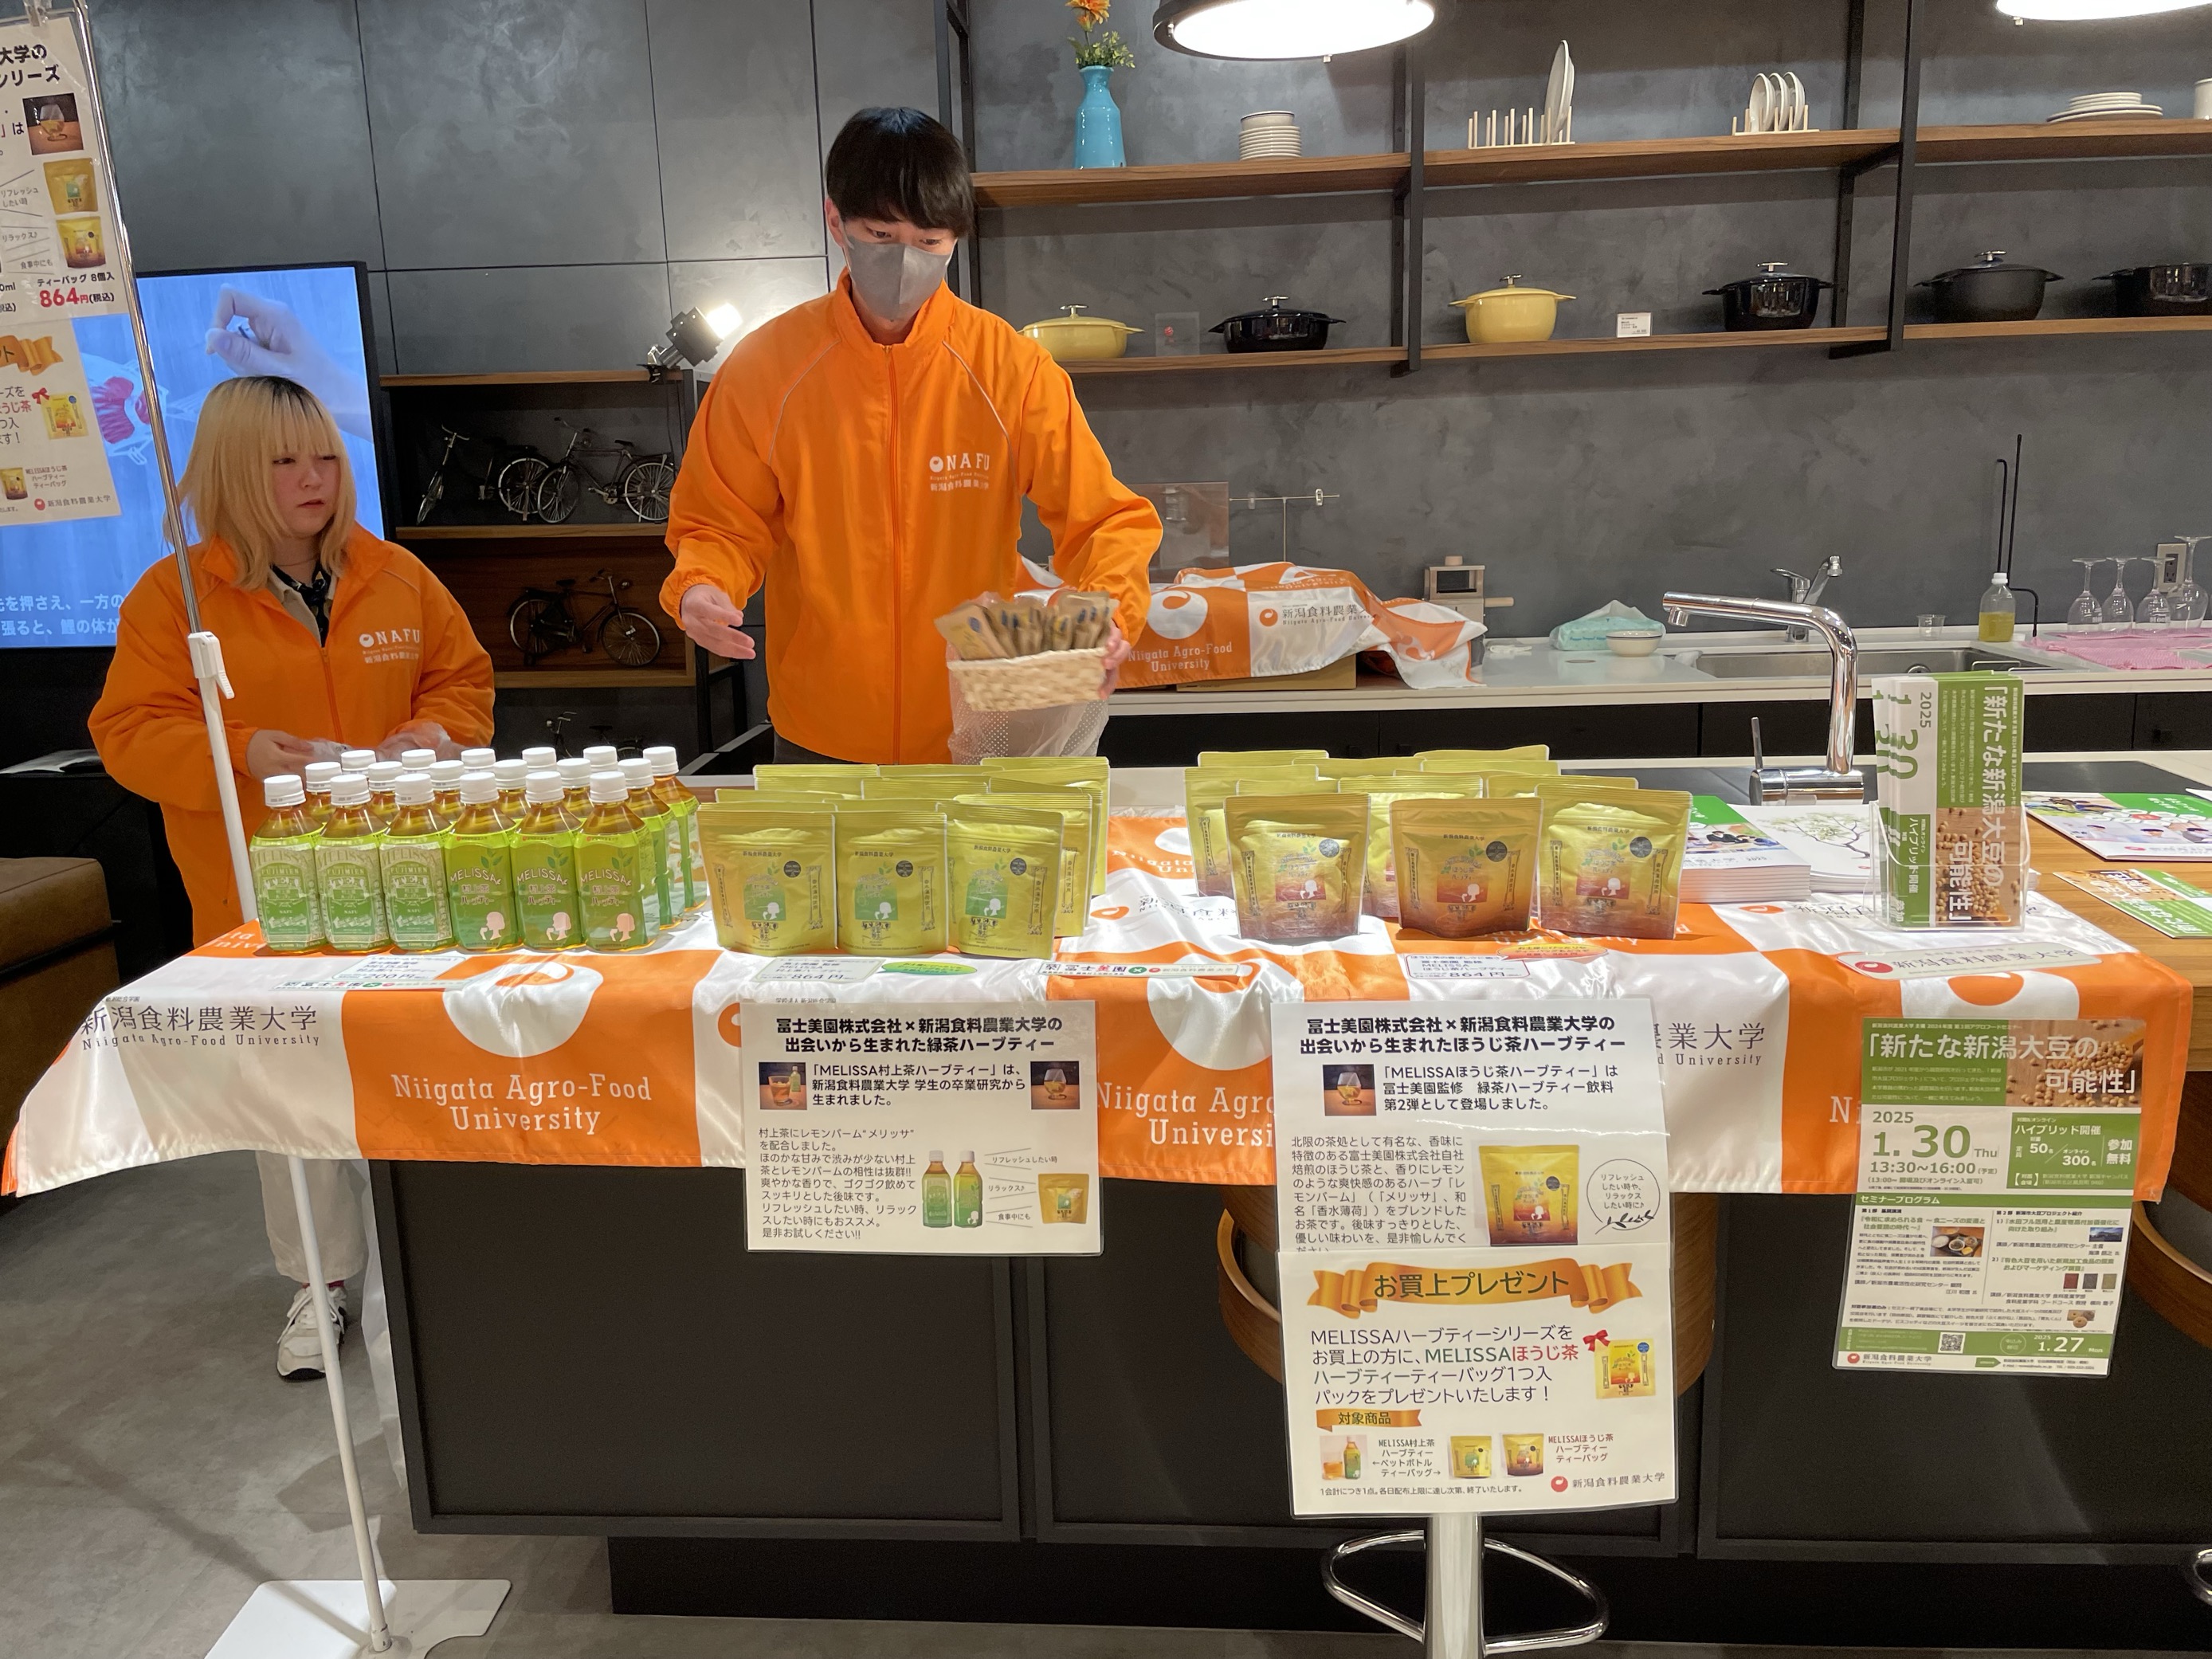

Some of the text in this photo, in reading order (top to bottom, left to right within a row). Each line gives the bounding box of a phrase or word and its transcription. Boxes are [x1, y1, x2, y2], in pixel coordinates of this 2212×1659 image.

[0, 44, 47, 65] 大学の
[946, 453, 990, 472] NAFU
[375, 628, 420, 645] NAFU
[1128, 641, 1232, 662] Niigata Agro-Food
[1151, 658, 1210, 672] University
[1919, 692, 1932, 729] 2025
[1982, 686, 2009, 887] 「新たな新潟大豆の
[451, 869, 496, 884] MELISSA
[518, 869, 563, 885] MELISSA
[580, 869, 626, 886] MELISSA
[1949, 841, 1974, 921] 可能性」
[80, 1005, 317, 1035] 新潟食料農業大学
[82, 1033, 320, 1050] Niigata Agro-Food University
[785, 1037, 1055, 1053] 出会いから生まれた緑茶ハーブティー
[1300, 1037, 1626, 1055] 出会いから生まれたほうじ茶ハーブティー
[1869, 1033, 2100, 1060] 「新たな新潟大豆の
[1675, 1053, 1763, 1066] University
[1383, 1065, 1618, 1079] 「MELISSAほうじ茶ハーブティー」は
[812, 1079, 1026, 1092] 新潟食料農業大学 学生の卒業研究から
[1477, 1081, 1614, 1094] 緑茶ハーブティー飲料
[2045, 1069, 2136, 1094] 可能性」
[391, 1073, 653, 1107] Niigata Agro-Food
[812, 1094, 892, 1107] 生まれました。
[1384, 1097, 1550, 1112] 第2弾として登場しました。
[449, 1106, 601, 1135] University
[1873, 1111, 1914, 1124] 2025
[2014, 1124, 2101, 1135] ハイブリッド開催
[759, 1140, 837, 1151] を配合しました。
[1292, 1135, 1463, 1147] 北限の茶処として有名な、香味に
[2107, 1139, 2132, 1151] 参加
[760, 1153, 916, 1165] ほのかな甘みで渋みが少ない村上
[992, 1155, 1058, 1164] リフレッシュしたい時
[1974, 1148, 1998, 1159] Thu
[2106, 1153, 2132, 1166] 無料
[1292, 1163, 1465, 1175] 焙煎のほうじ茶と、香りにレモン
[1292, 1177, 1465, 1190] のような爽快感のあるハーブ「レ
[1600, 1173, 1645, 1182] リフレッシュ
[761, 1179, 916, 1190] 爽やかな香りで、ゴクゴク飲めて
[762, 1190, 880, 1202] スッキリとした後味です。
[1605, 1192, 1641, 1201] リラックス
[1860, 1195, 1940, 1205] セミナープログラム
[763, 1203, 916, 1215] リフレッシュしたい時、リラック
[763, 1215, 881, 1227] スしたい時にもおススメ。
[998, 1213, 1031, 1222] 食事中にも
[1295, 1218, 1463, 1231] お茶です。後味すっきりとした、
[1373, 1270, 1570, 1300] お買上プレゼント
[1311, 1324, 1573, 1346] MELISSAハーブティーシリーズを
[1338, 1411, 1391, 1426] 対象商品
[1379, 1438, 1434, 1448] MELISSA村上茶
[1547, 1433, 1614, 1445] MELISSAほうじ茶
[1381, 1449, 1433, 1457] ハーブティー
[1555, 1444, 1608, 1454] ハーブティー
[1380, 1458, 1433, 1468] ペットボトル
[1556, 1453, 1609, 1463] ティーバッグ
[1381, 1468, 1433, 1477] ティーバッグ
[1572, 1473, 1665, 1489] 新潟食料農業大学
